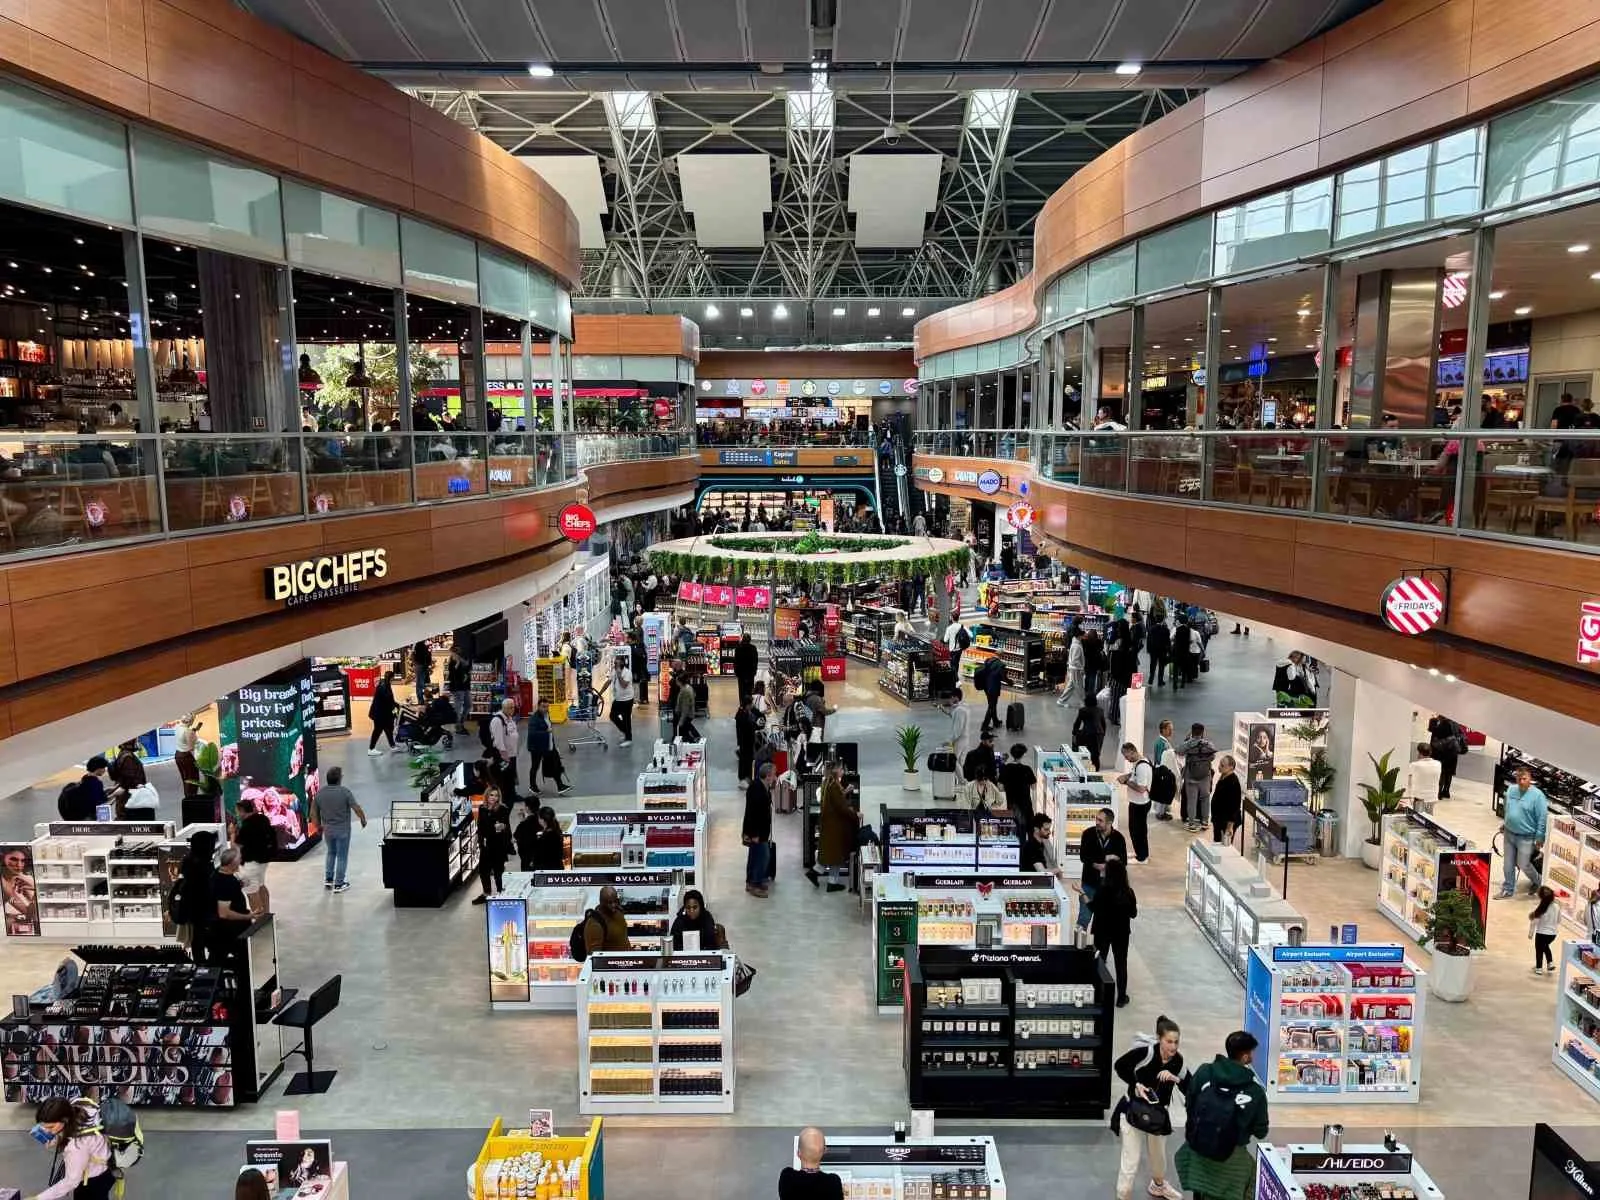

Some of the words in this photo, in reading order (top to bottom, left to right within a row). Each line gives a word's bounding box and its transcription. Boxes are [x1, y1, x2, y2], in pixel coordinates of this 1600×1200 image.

[565, 513, 580, 521] BIG
[565, 520, 591, 528] CHEFS
[273, 548, 387, 601] BIGCHEFS
[1398, 601, 1435, 611] FRIDAYS
[239, 688, 262, 703] Big
[240, 703, 272, 716] Duty
[241, 719, 285, 731] prices.
[241, 731, 262, 741] Shop
[935, 878, 965, 886] GUERLAIN
[1002, 878, 1033, 886] GUERLAIN
[40, 1044, 190, 1084] NUDES
[1317, 1157, 1385, 1169] SHISEIDO
